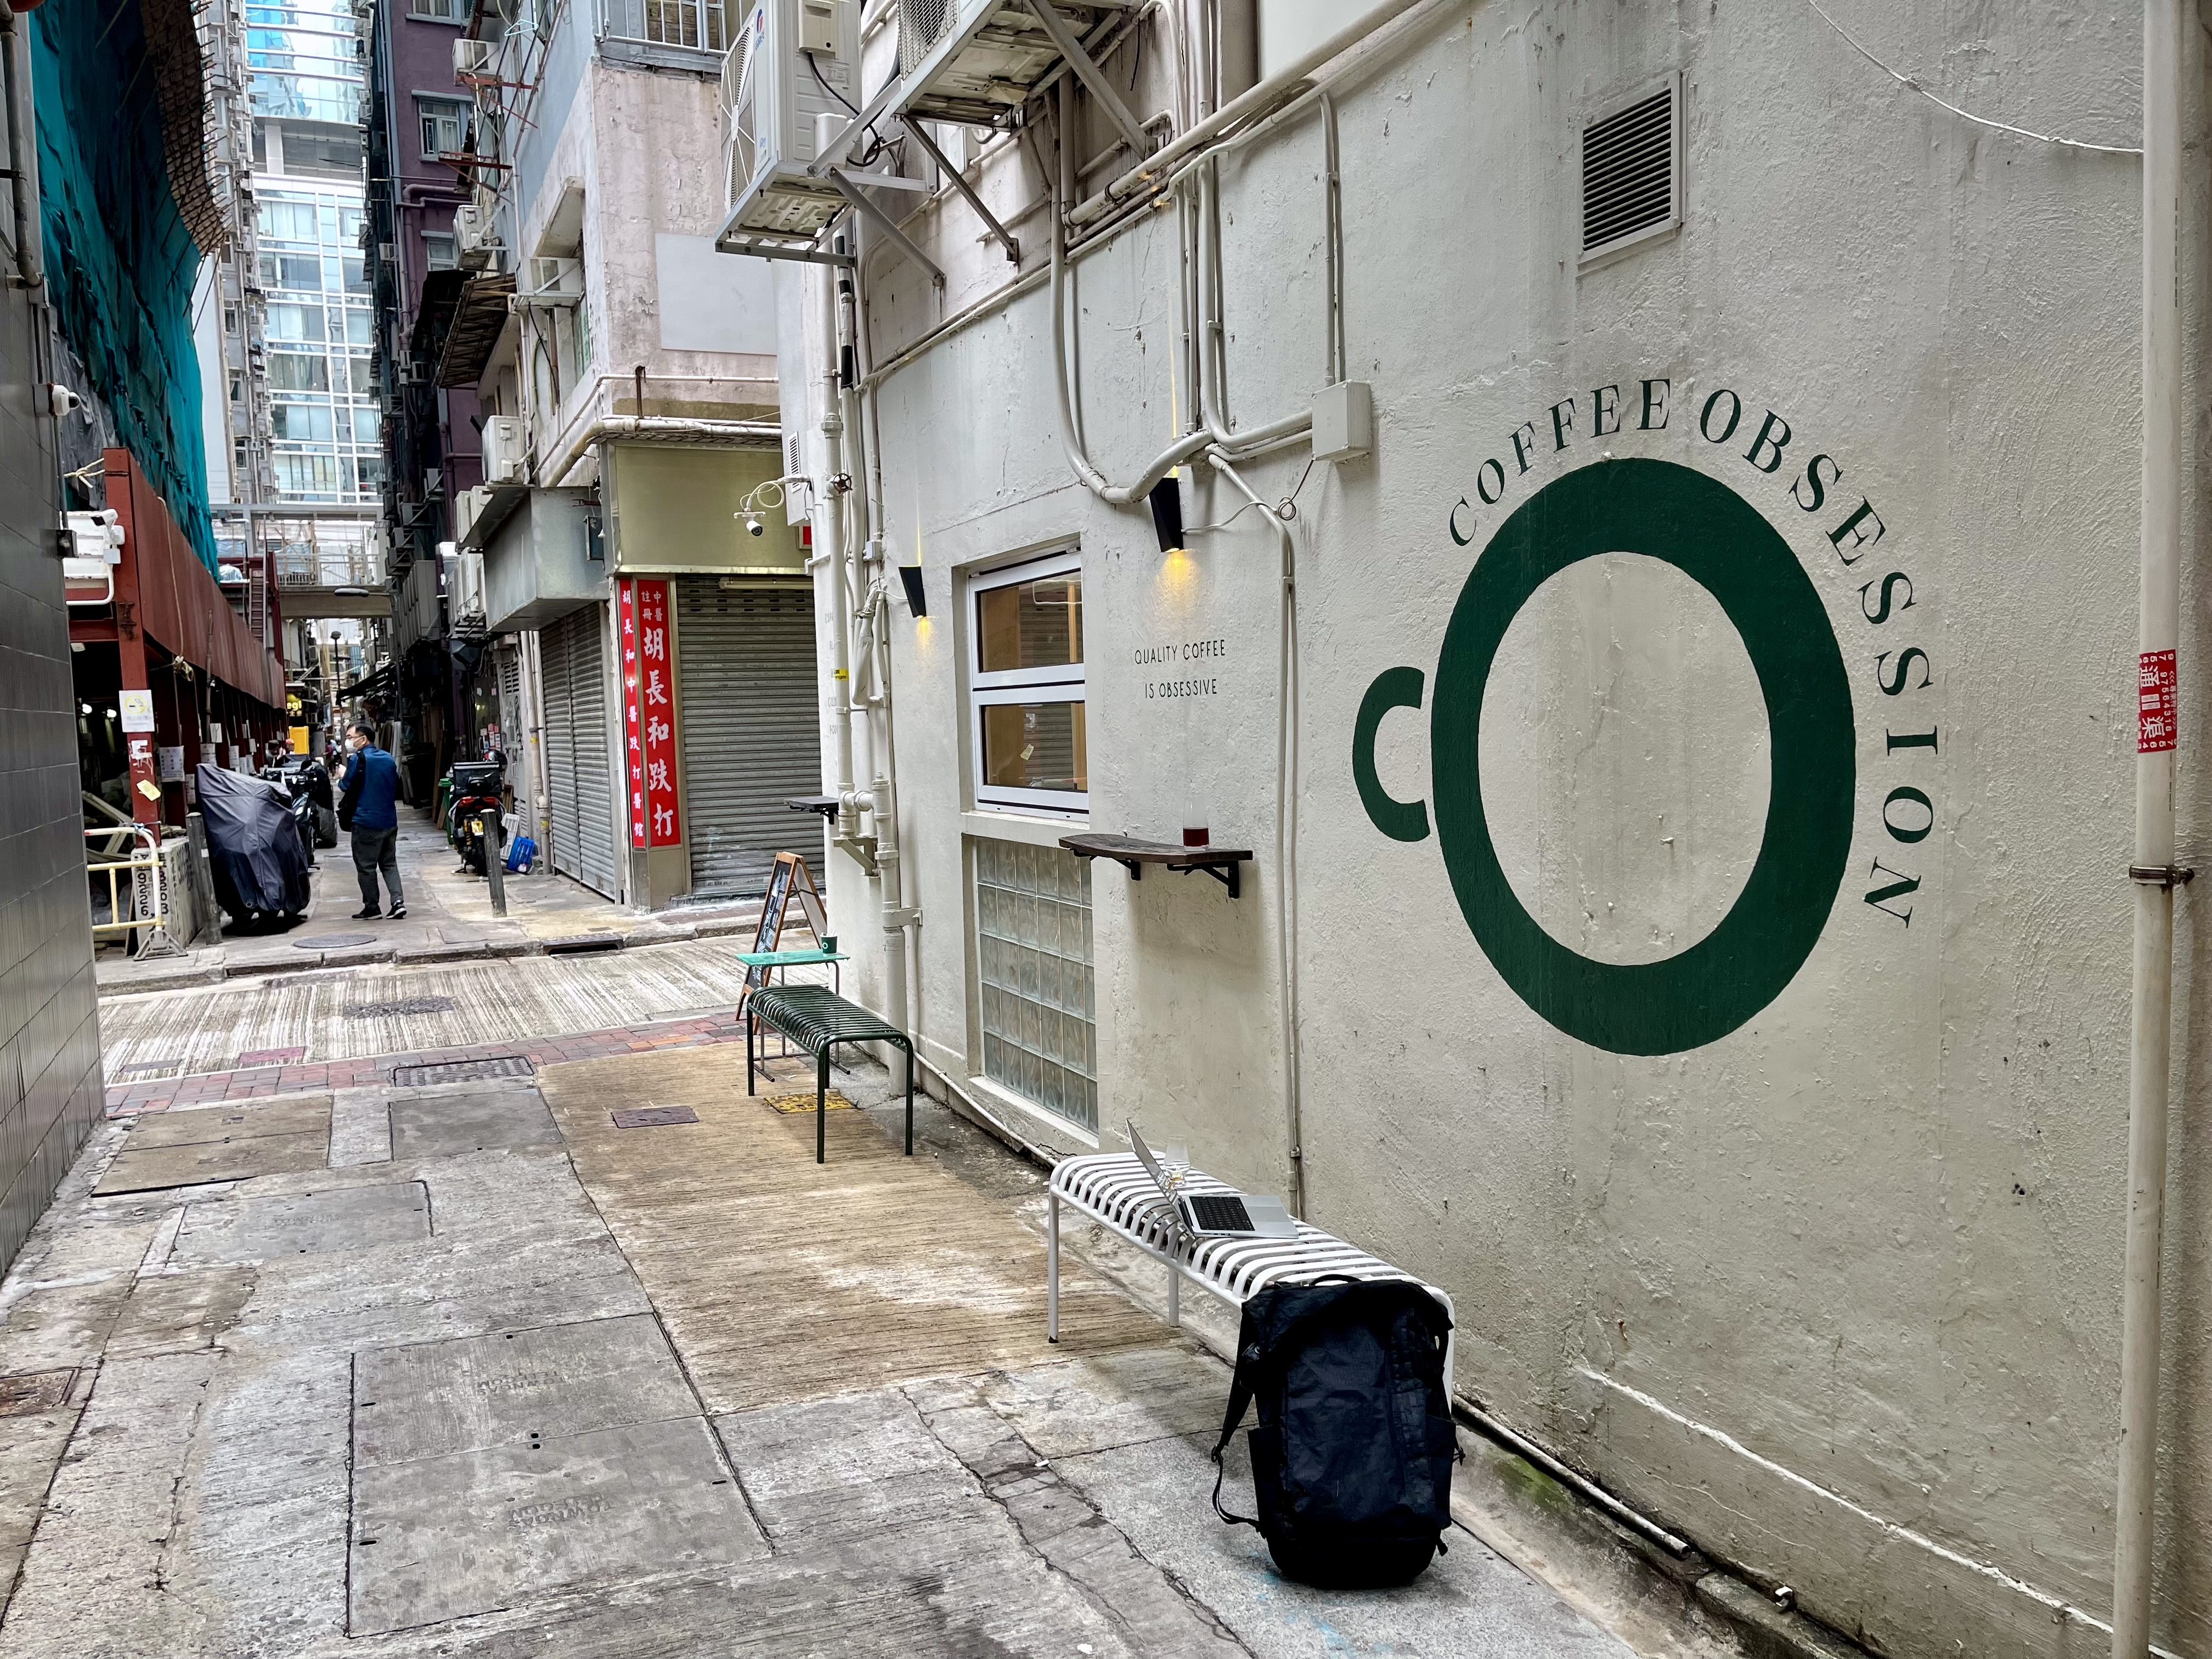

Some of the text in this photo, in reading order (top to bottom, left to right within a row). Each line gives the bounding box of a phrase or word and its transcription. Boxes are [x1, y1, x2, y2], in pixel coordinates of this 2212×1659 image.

[1135, 640, 1225, 664] QUALITY COFFEE
[1145, 679, 1217, 699] IS OBSESSIVE
[1449, 379, 1938, 929] COFFEE OBSESSION
[643, 627, 674, 837] 胡長和跌打
